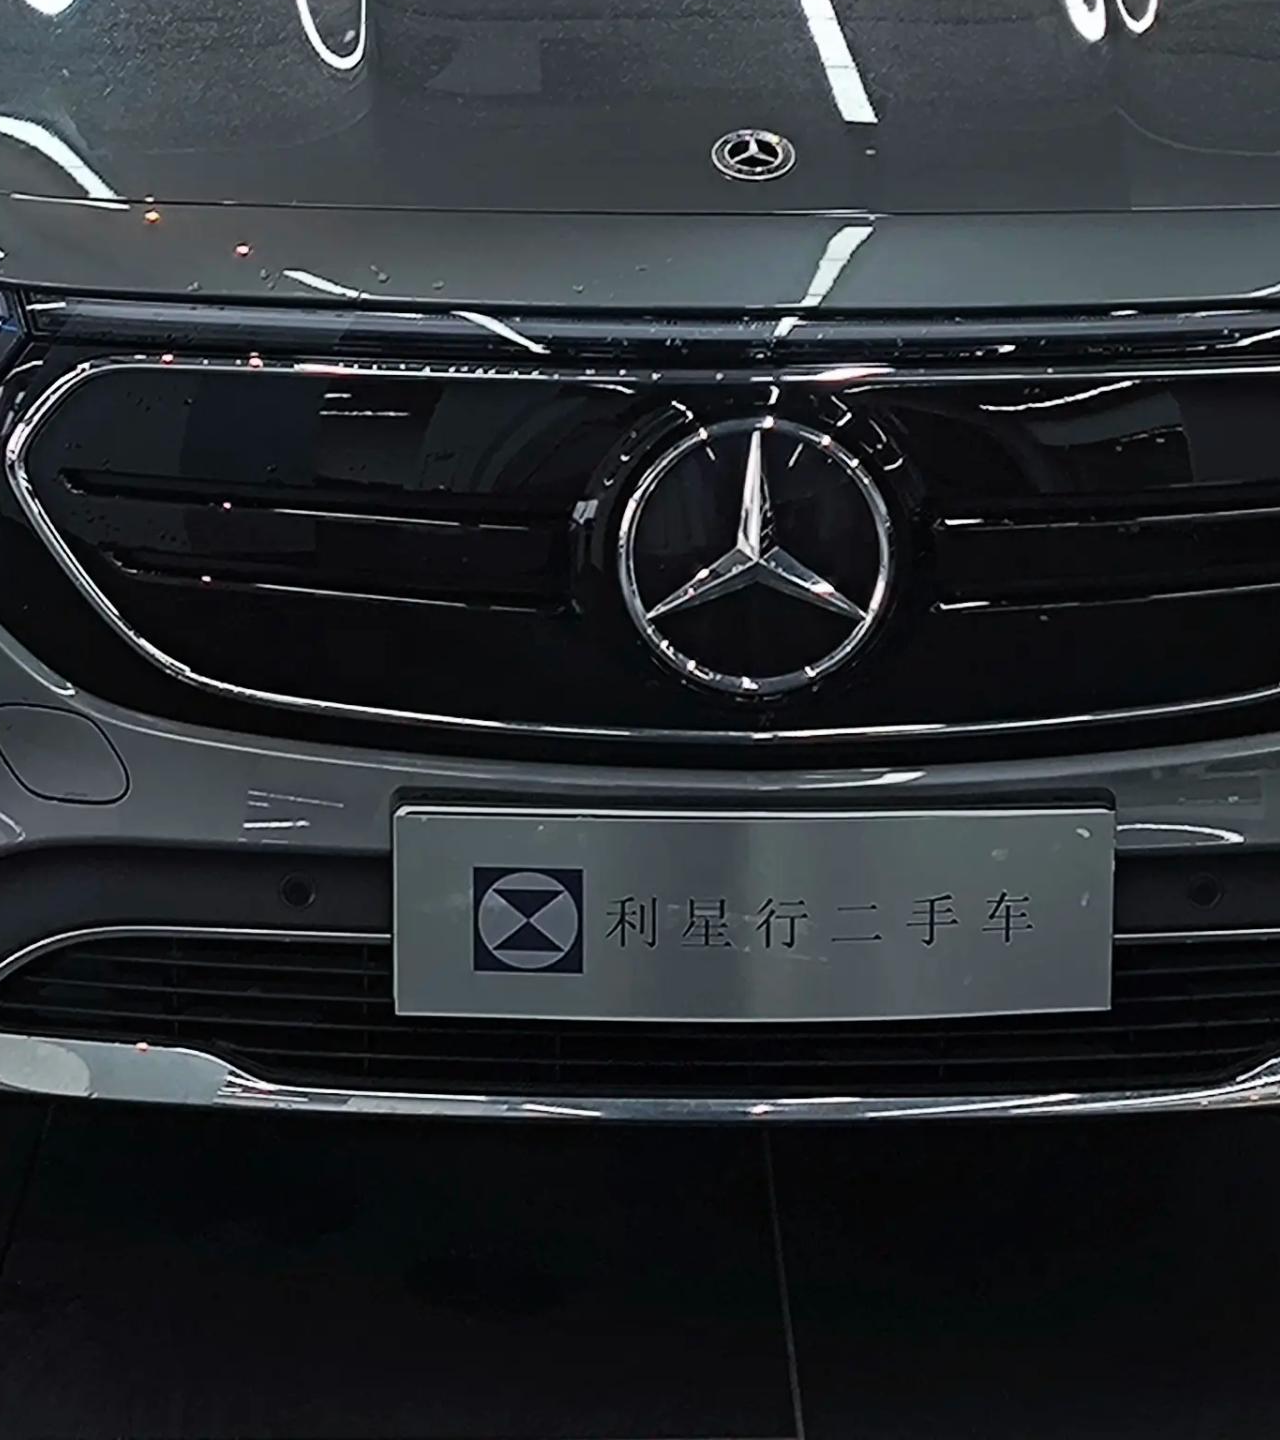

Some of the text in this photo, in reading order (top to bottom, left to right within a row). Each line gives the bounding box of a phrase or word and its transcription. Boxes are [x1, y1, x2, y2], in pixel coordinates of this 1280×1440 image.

[606, 890, 1034, 949] 利星行二手车
